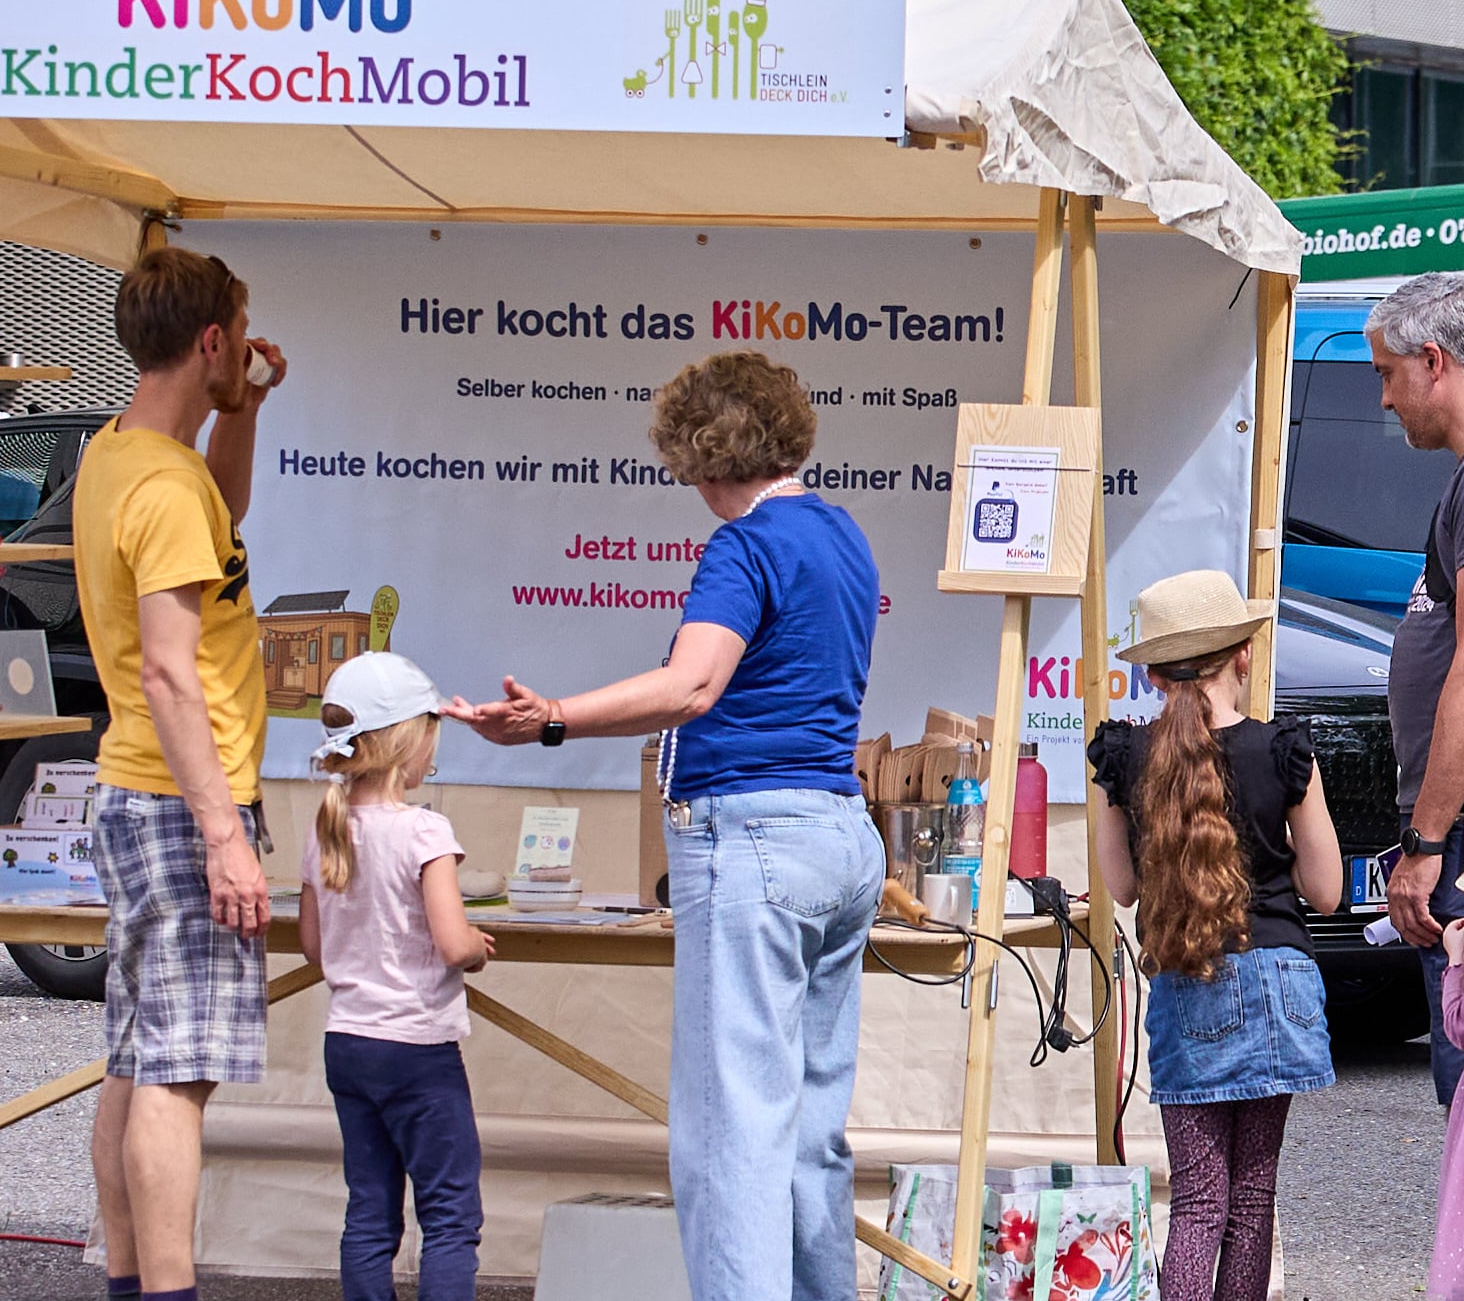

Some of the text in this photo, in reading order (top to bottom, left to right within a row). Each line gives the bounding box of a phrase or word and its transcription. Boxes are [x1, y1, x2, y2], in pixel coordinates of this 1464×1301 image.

[1, 45, 530, 107] KinderKochMobil
[761, 73, 828, 87] TISCHLEIN
[760, 89, 792, 102] DECK
[797, 90, 828, 103] DICH
[400, 298, 1004, 342] Hier kocht das KiKoMo-Team!
[456, 378, 525, 399] Selber
[532, 380, 607, 401] kochen
[862, 388, 896, 406] mit
[902, 387, 957, 410] Spaß
[279, 449, 366, 477] Heute
[376, 451, 485, 480] kochen
[496, 455, 542, 482] wir
[552, 457, 600, 484] mit
[802, 462, 902, 491] deiner
[565, 534, 637, 562] Jetzt
[1006, 548, 1045, 560] KiKoMo
[1026, 734, 1039, 743] Ein
[1041, 735, 1070, 745] Projekt
[1355, 886, 1362, 896] D
